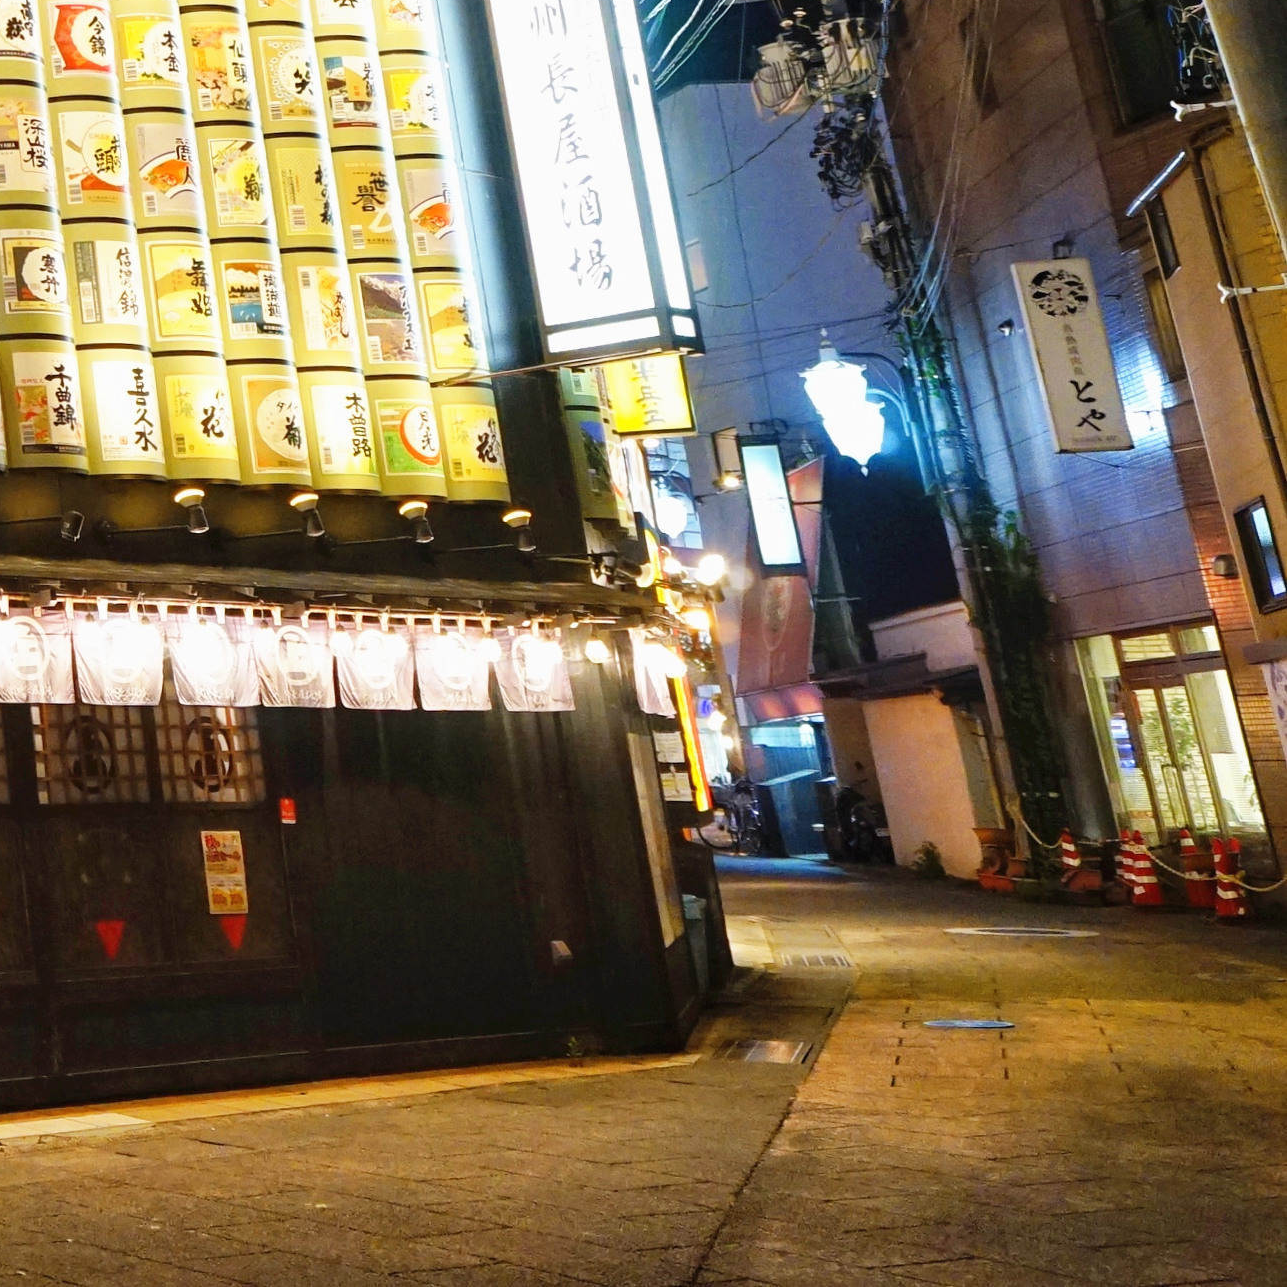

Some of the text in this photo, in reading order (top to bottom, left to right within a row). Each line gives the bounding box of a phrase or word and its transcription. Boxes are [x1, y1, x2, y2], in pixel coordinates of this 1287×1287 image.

[44, 363, 78, 431] 千曲錦
[126, 367, 158, 453] 喜久水
